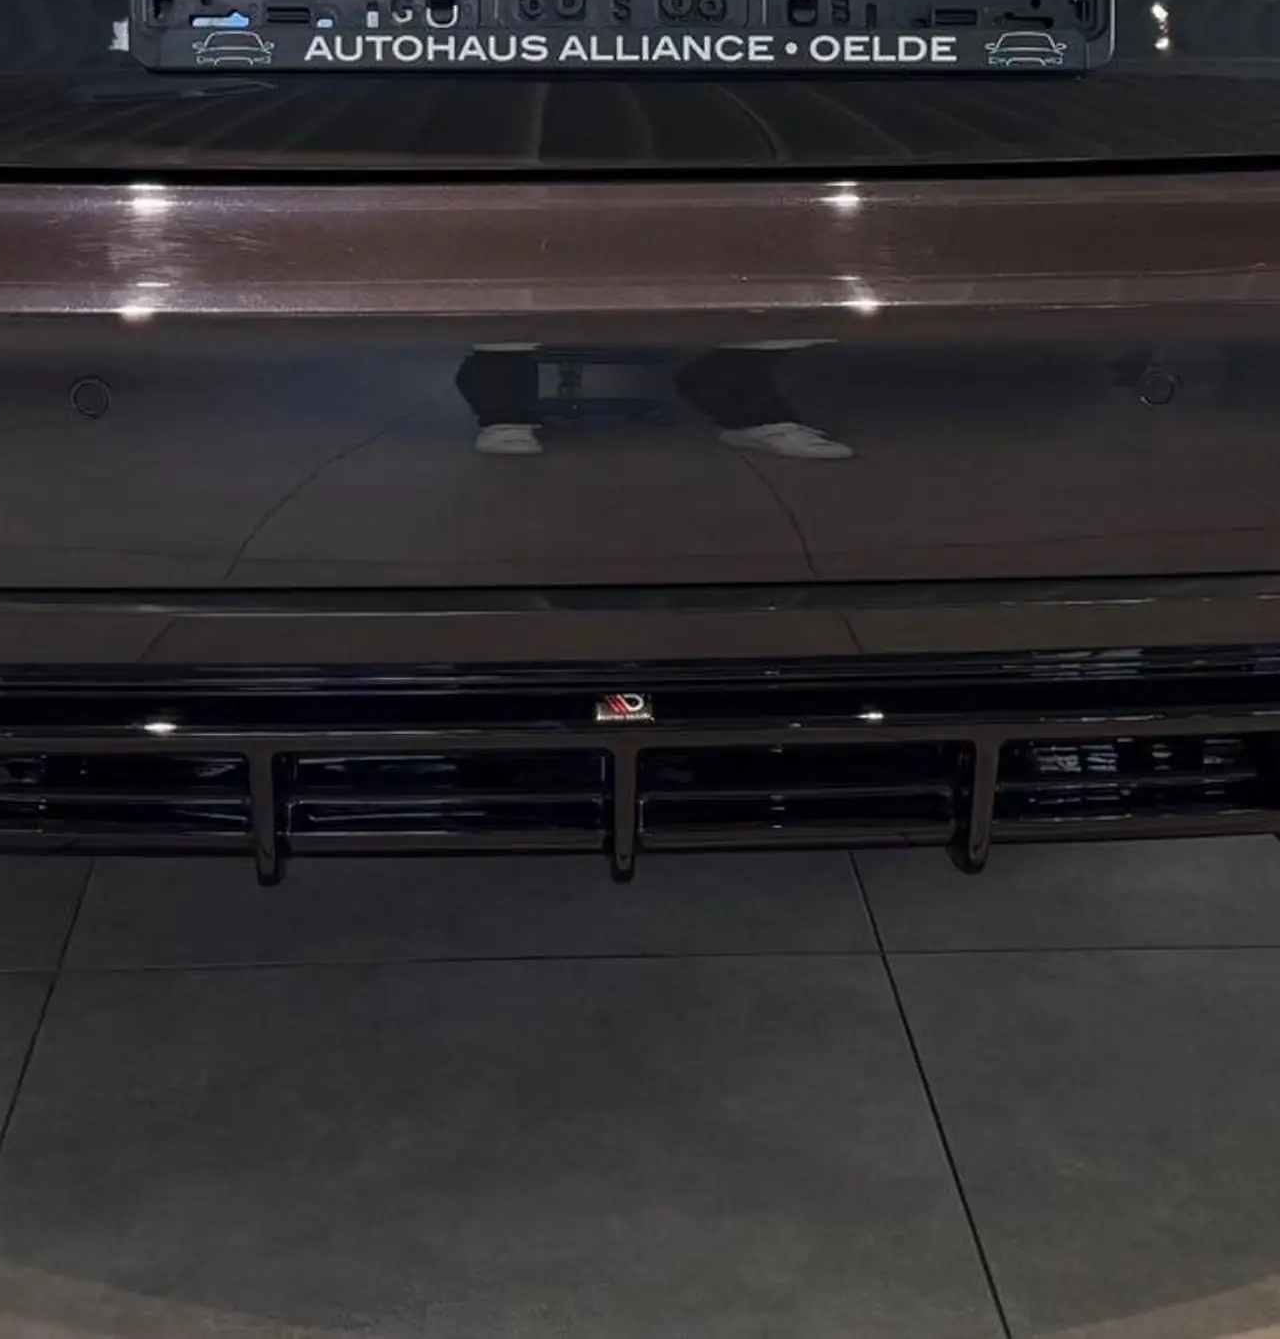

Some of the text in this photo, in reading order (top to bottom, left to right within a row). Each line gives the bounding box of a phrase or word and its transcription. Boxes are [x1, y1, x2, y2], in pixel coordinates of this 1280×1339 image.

[303, 34, 958, 62] AUTOHAUS ALLIANCE OELDE
